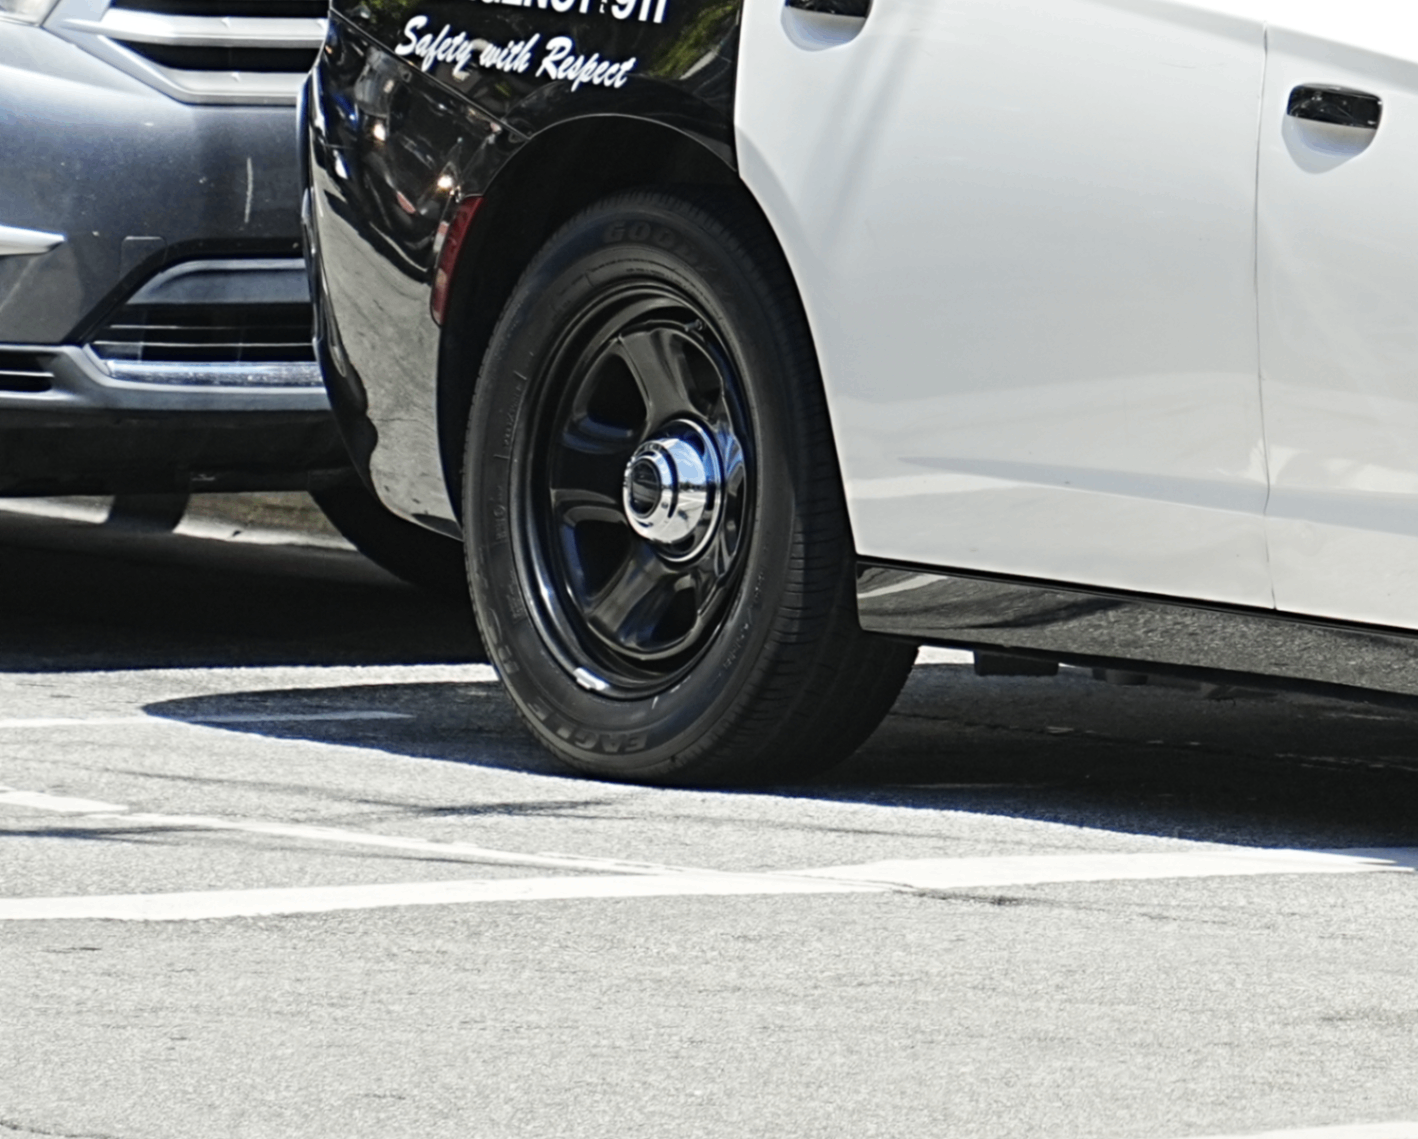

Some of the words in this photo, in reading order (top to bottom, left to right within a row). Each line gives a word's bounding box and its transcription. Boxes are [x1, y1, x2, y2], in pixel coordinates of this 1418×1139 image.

[395, 15, 473, 78] Safety
[479, 33, 540, 73] with
[535, 36, 636, 92] Respect
